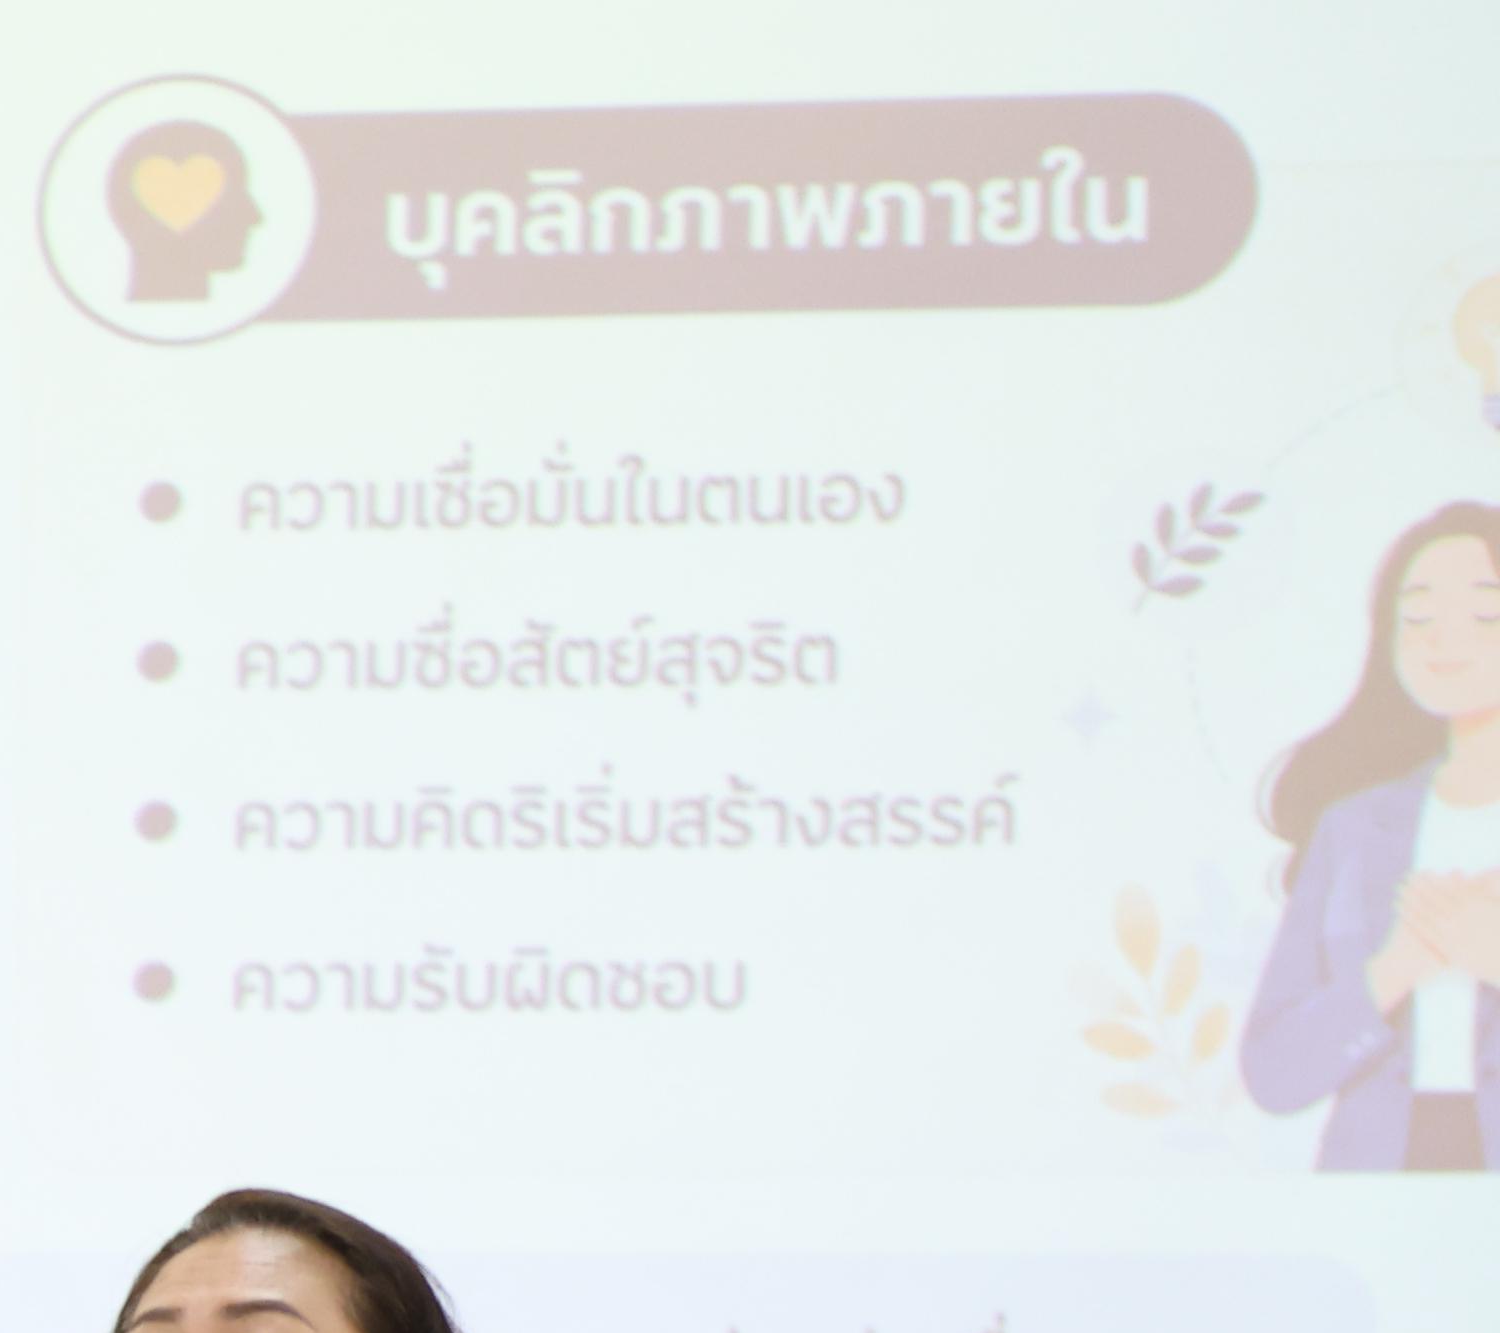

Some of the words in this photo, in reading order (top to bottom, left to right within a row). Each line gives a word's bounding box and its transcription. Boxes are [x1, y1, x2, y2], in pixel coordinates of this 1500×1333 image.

[386, 146, 1148, 289] บุคลิกภาพภายใน
[238, 439, 907, 531] ความเชื่อมั่นในตนเอง
[235, 601, 840, 708] ความซื่อสัตย์สุจริต
[233, 761, 1021, 851] ความคิดริเริ่มสร้างสรรค์
[231, 944, 747, 1012] ความรับผิดชอบ
